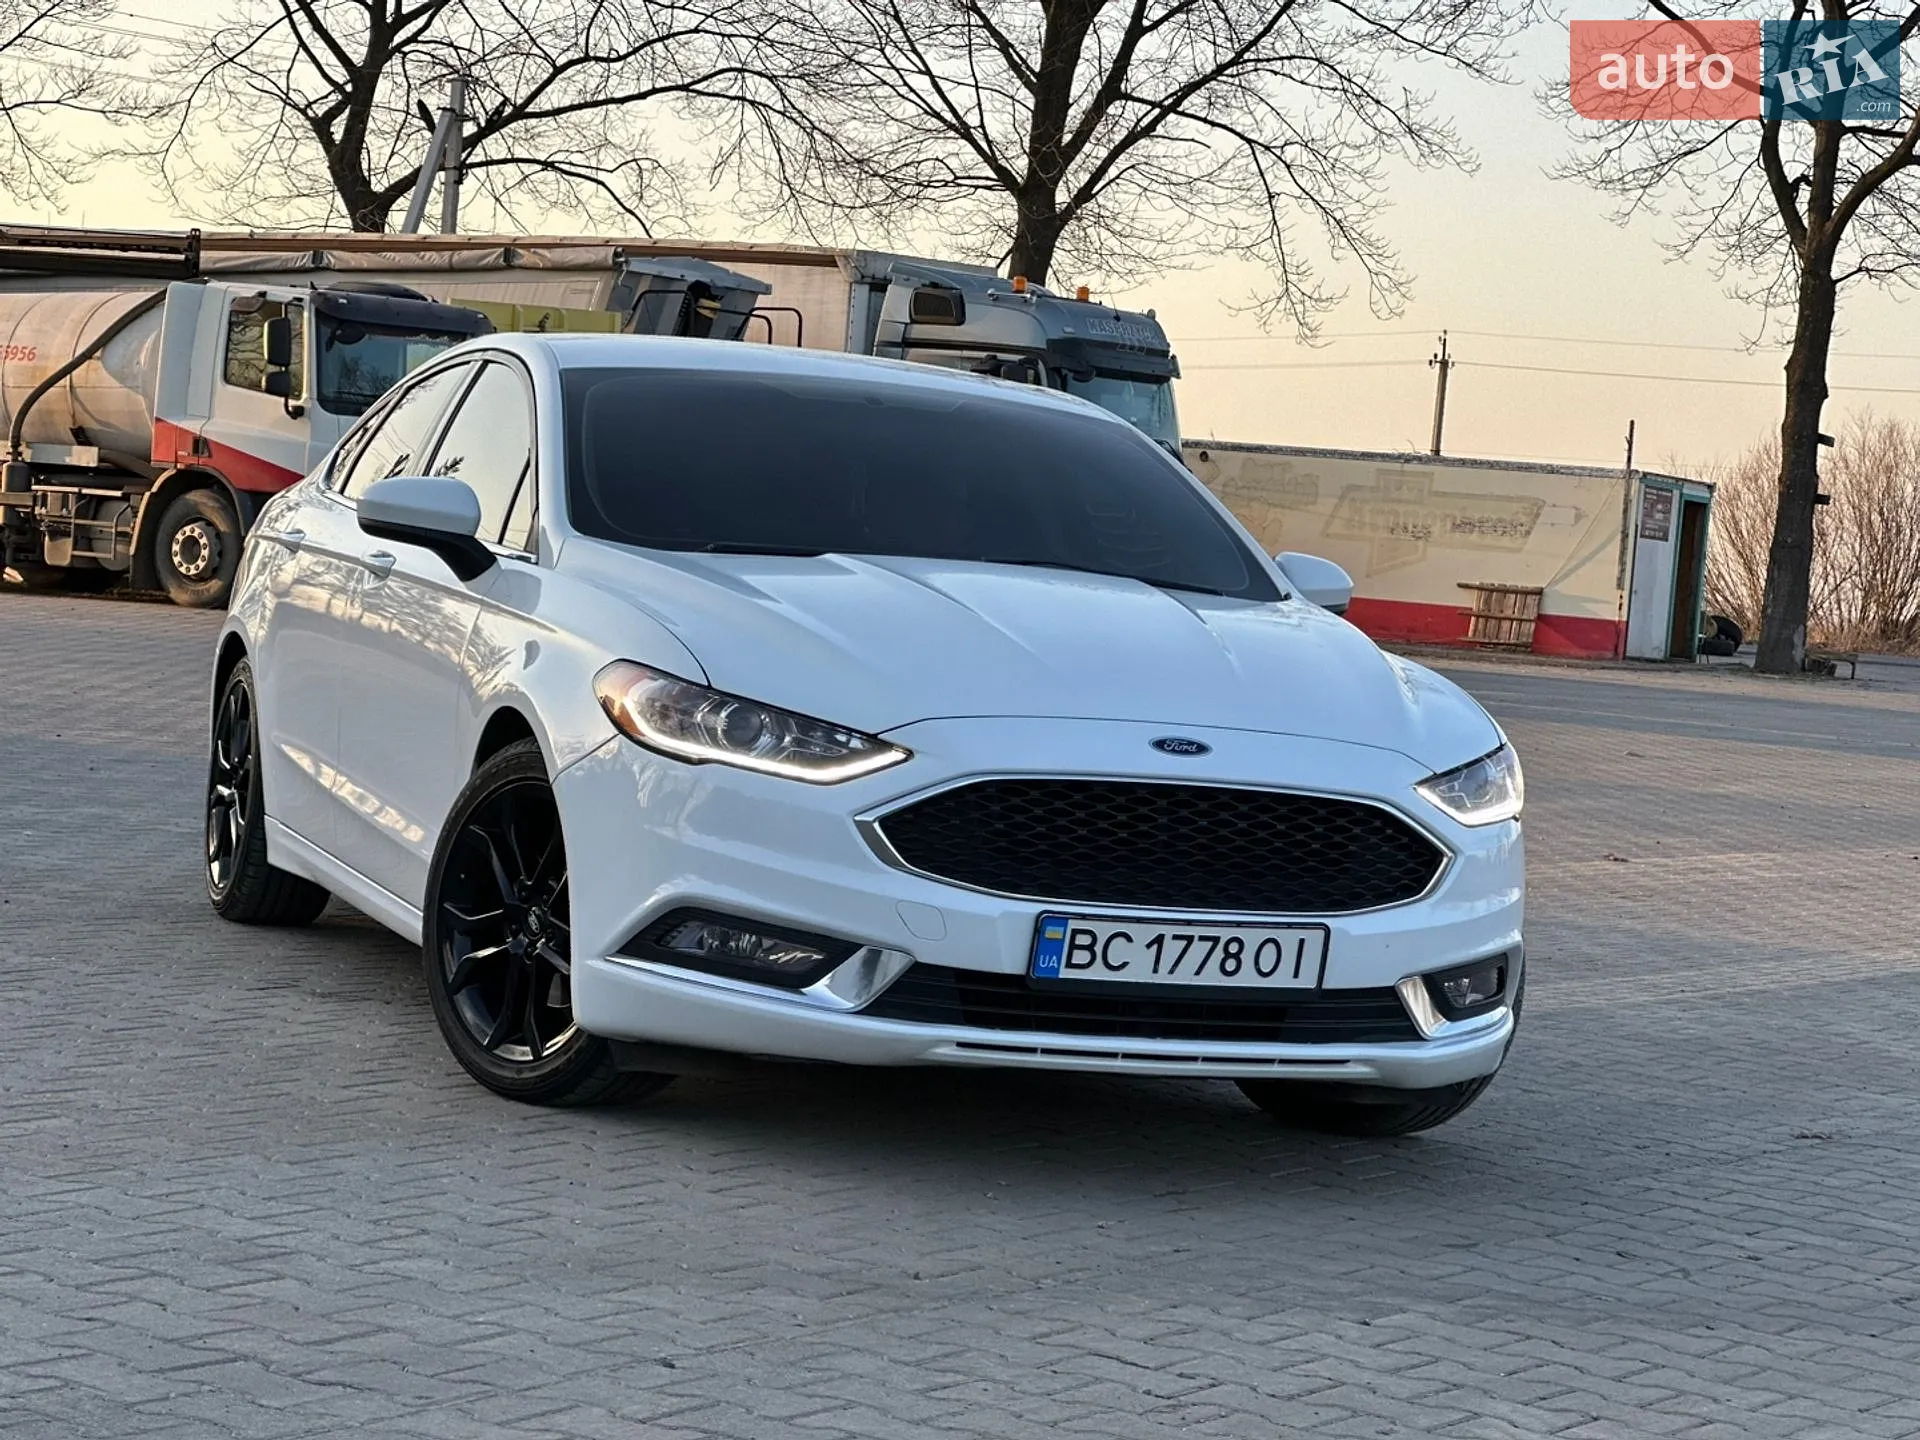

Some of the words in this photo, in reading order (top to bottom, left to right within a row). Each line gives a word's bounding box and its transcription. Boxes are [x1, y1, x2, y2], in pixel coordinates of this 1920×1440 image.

[0, 344, 37, 361] 5956
[1164, 739, 1198, 752] Ford
[1039, 954, 1058, 968] UA
